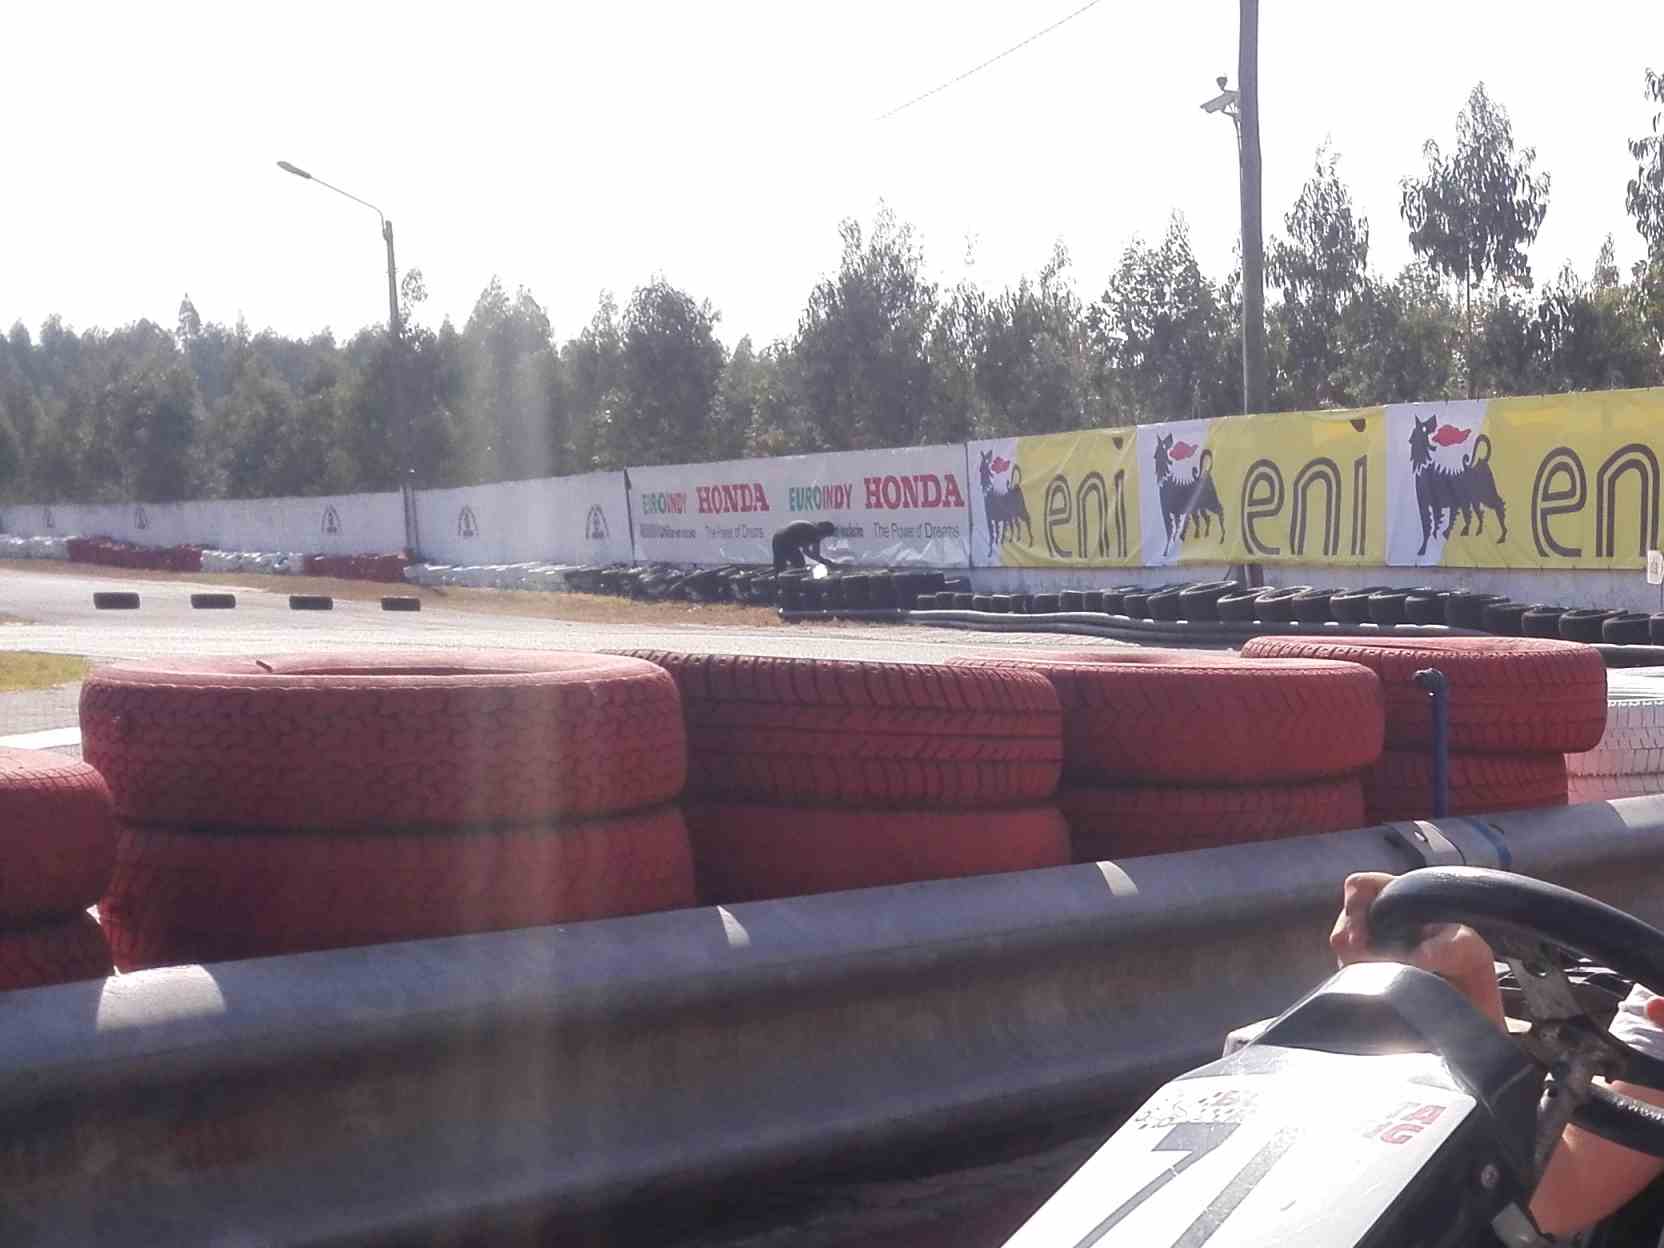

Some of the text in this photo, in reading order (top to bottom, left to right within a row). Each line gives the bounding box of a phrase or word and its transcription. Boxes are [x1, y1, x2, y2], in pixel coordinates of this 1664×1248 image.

[695, 482, 770, 514] HONDA
[789, 473, 966, 512] EUROINDY HONDA
[1043, 436, 1128, 559] eni
[1240, 418, 1369, 558] eni
